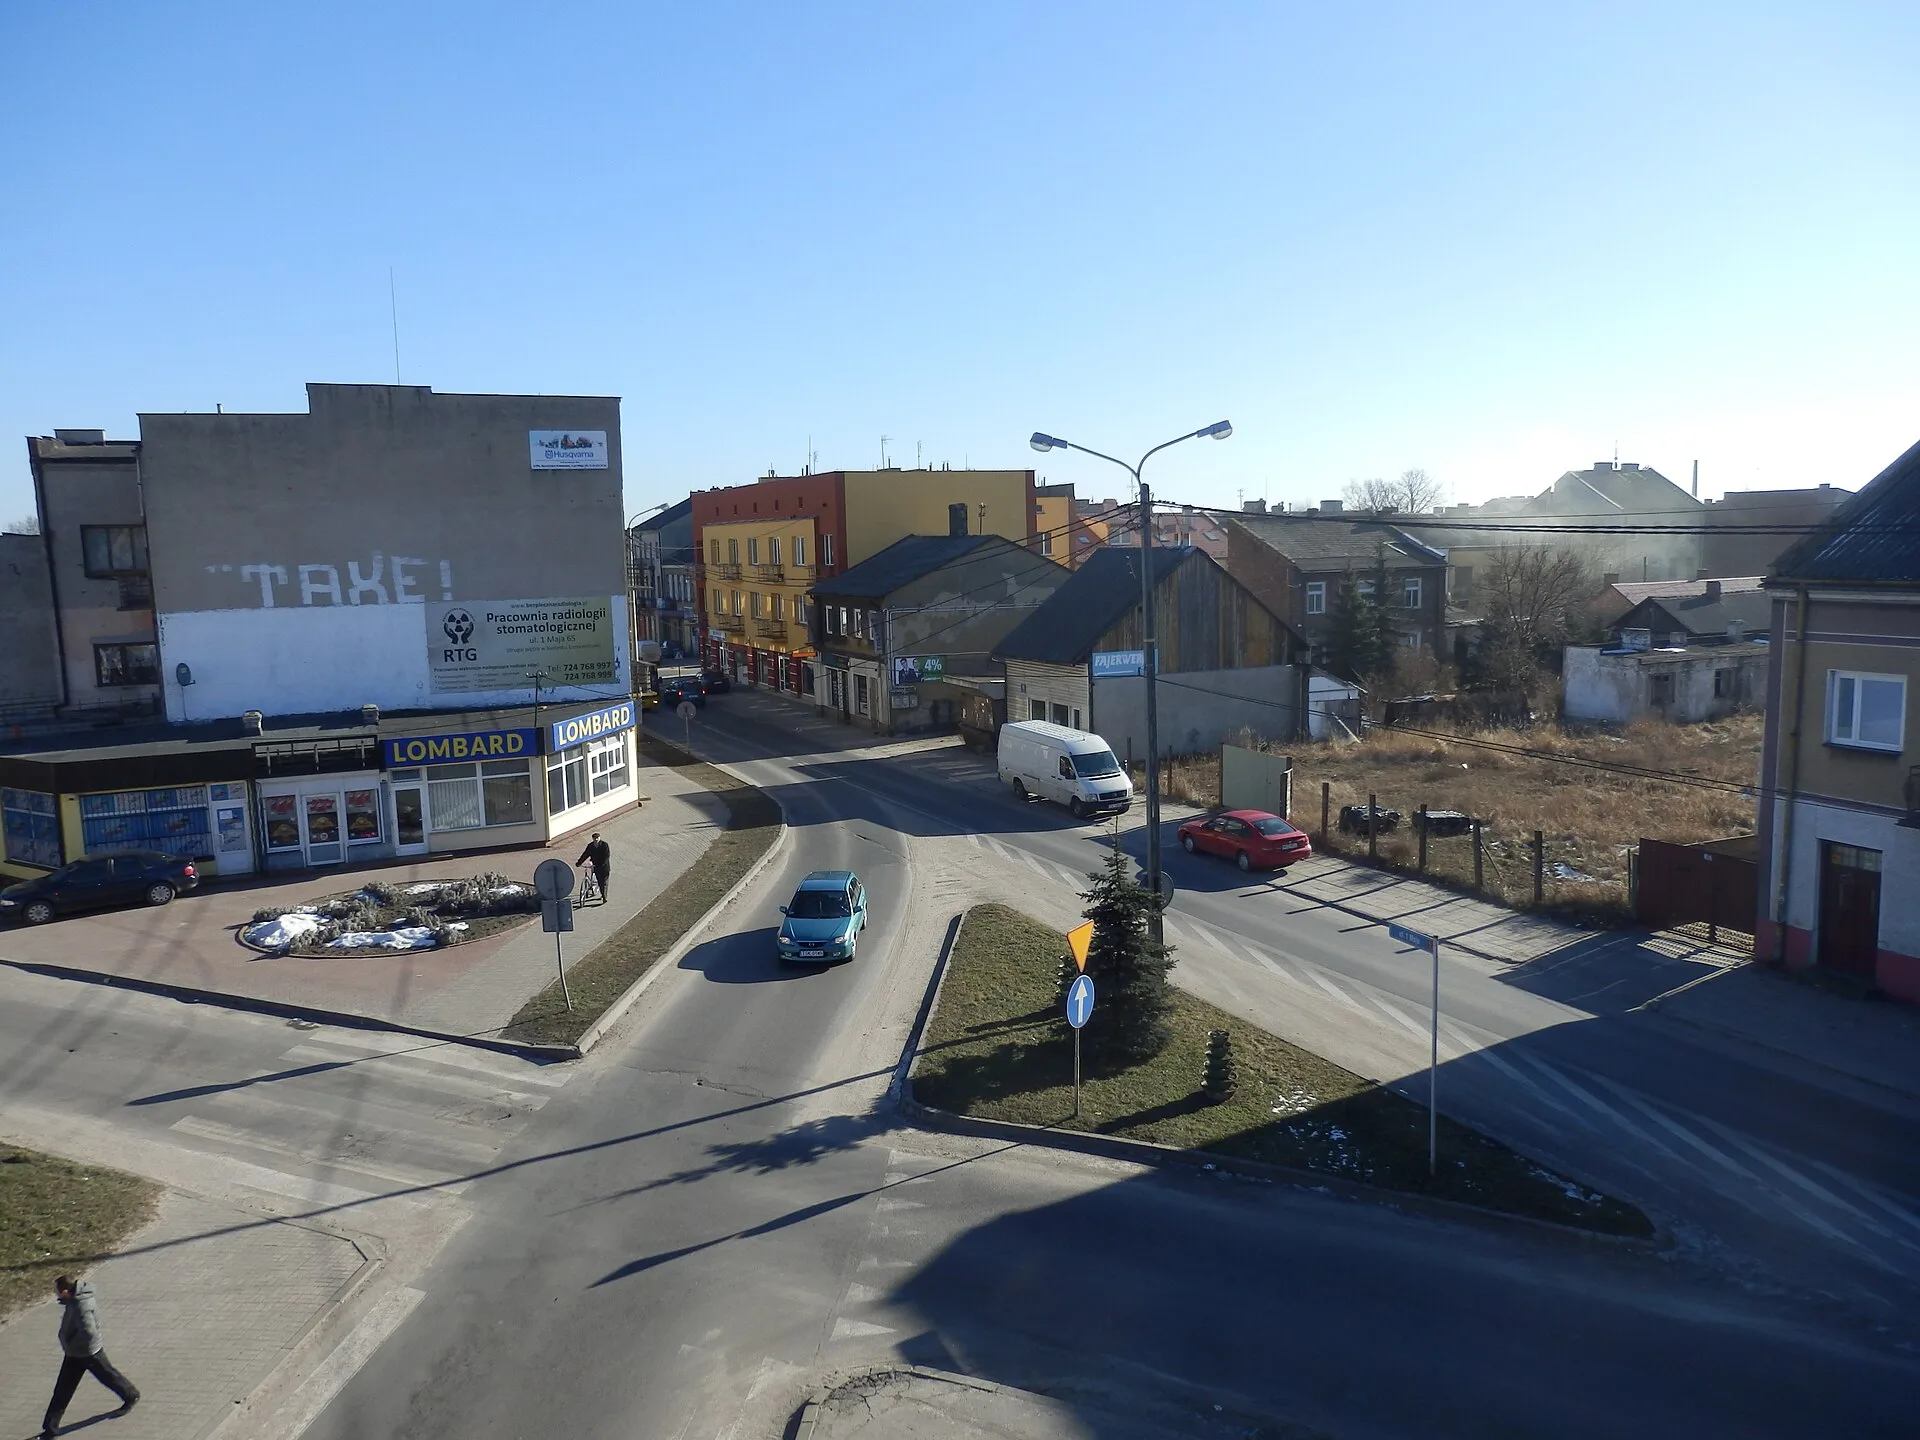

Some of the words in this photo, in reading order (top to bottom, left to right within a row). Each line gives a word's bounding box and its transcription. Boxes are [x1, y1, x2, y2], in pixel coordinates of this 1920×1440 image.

[554, 450, 594, 459] Husqvarna
[486, 611, 548, 623] Pracownia
[553, 608, 606, 620] radiologii
[497, 620, 596, 635] stomatologicznej
[529, 636, 539, 644] ul.
[547, 635, 566, 645] Maja
[444, 648, 477, 662] RTG
[1095, 653, 1144, 669] FAJERWER
[563, 664, 578, 672] 724
[580, 662, 595, 670] 768
[596, 661, 611, 669] 997
[924, 658, 942, 671] 4%
[564, 673, 579, 681] 724
[581, 671, 596, 679] 768
[597, 670, 612, 678] 999
[558, 706, 630, 746] LOMBARD
[393, 733, 524, 763] LOMBARD
